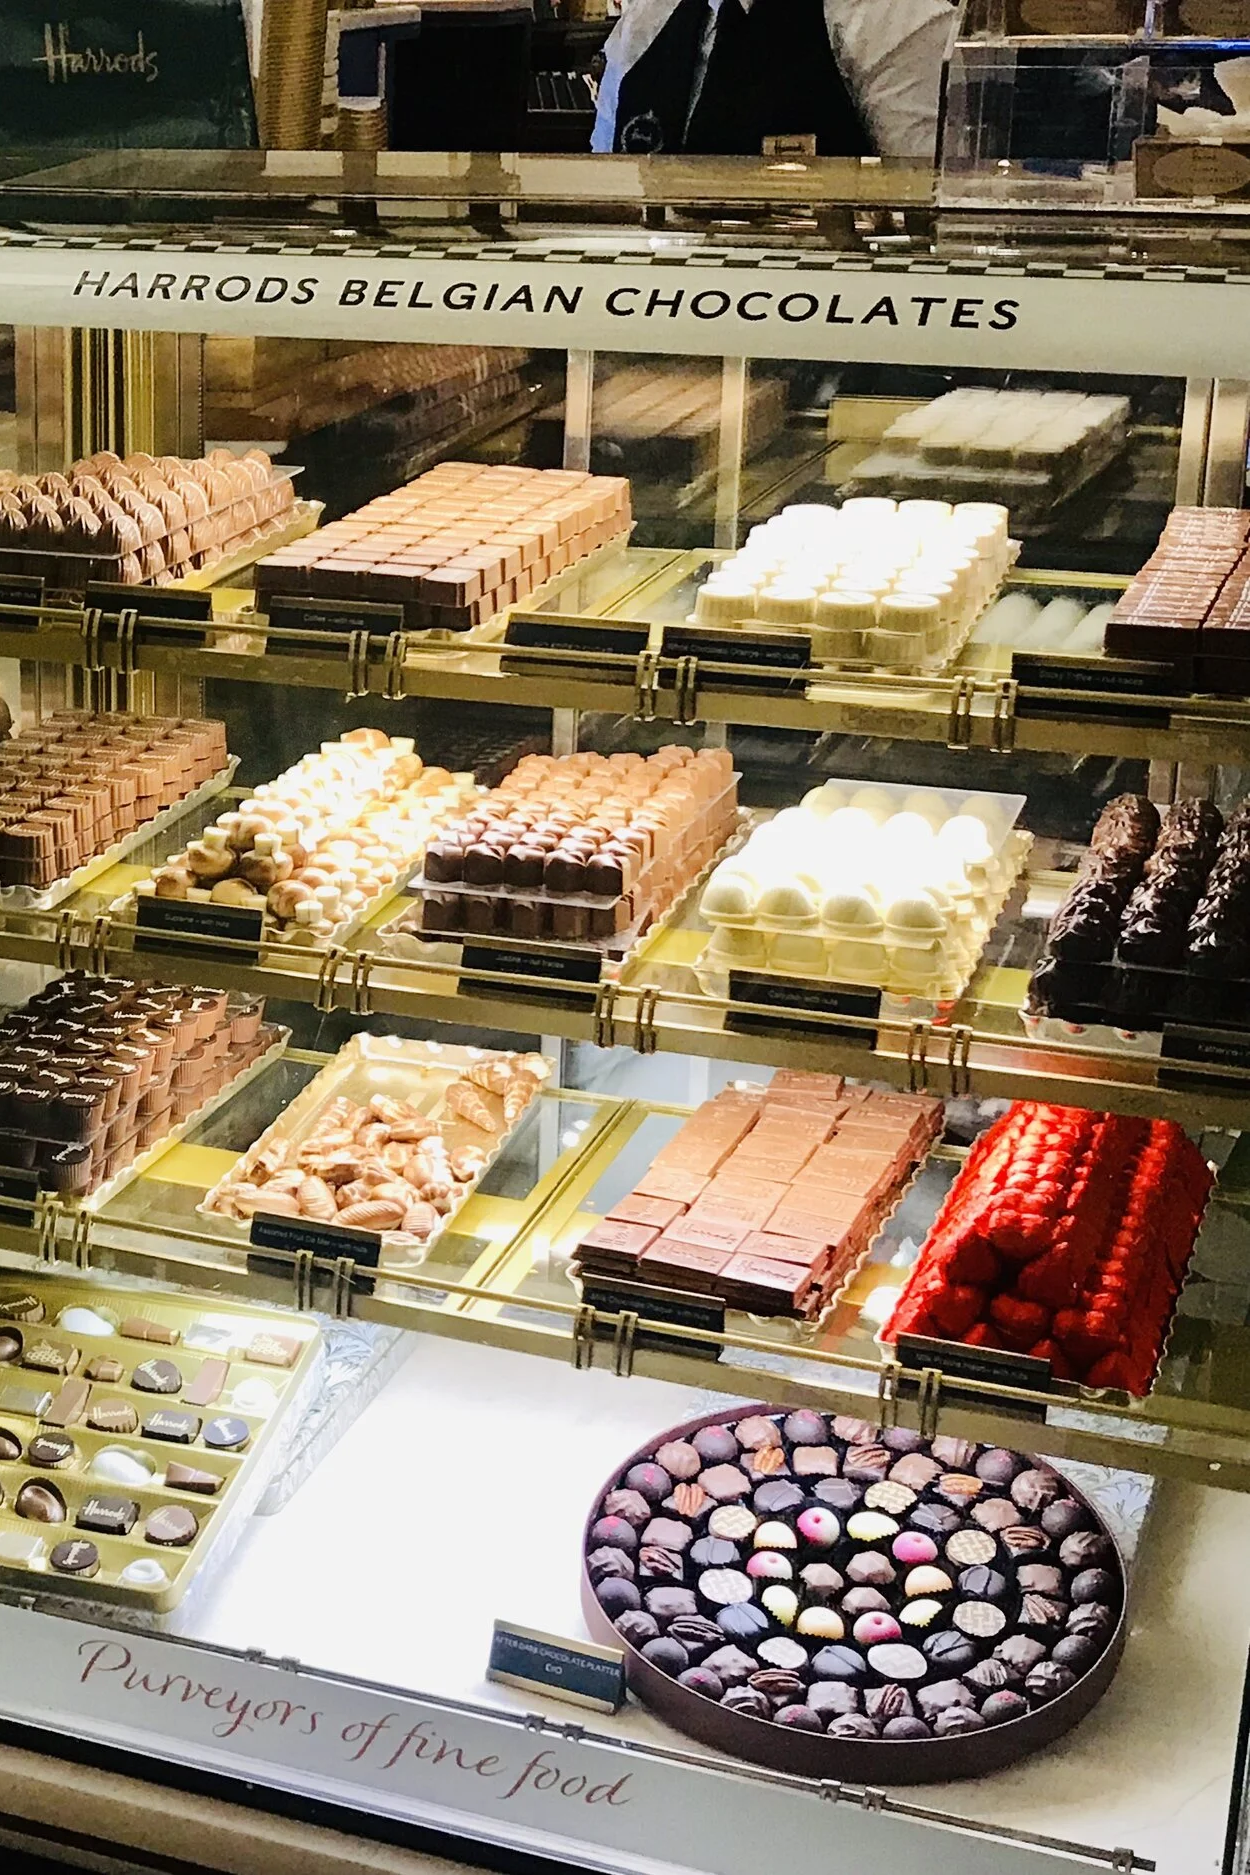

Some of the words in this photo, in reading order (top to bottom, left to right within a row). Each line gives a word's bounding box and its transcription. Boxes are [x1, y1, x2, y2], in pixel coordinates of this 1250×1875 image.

[32, 22, 158, 83] Harrods
[73, 270, 319, 305] HARRODS
[338, 278, 583, 314] BELGIAN
[605, 286, 1020, 330] CHOCOLATES
[495, 1634, 519, 1649] AFTER
[539, 1646, 587, 1669] CHOCOLATE
[585, 1661, 621, 1678] PLATTER
[78, 1639, 324, 1738] Purveyors
[340, 1712, 399, 1762] of
[379, 1720, 507, 1777] fine
[496, 1750, 633, 1806] food
